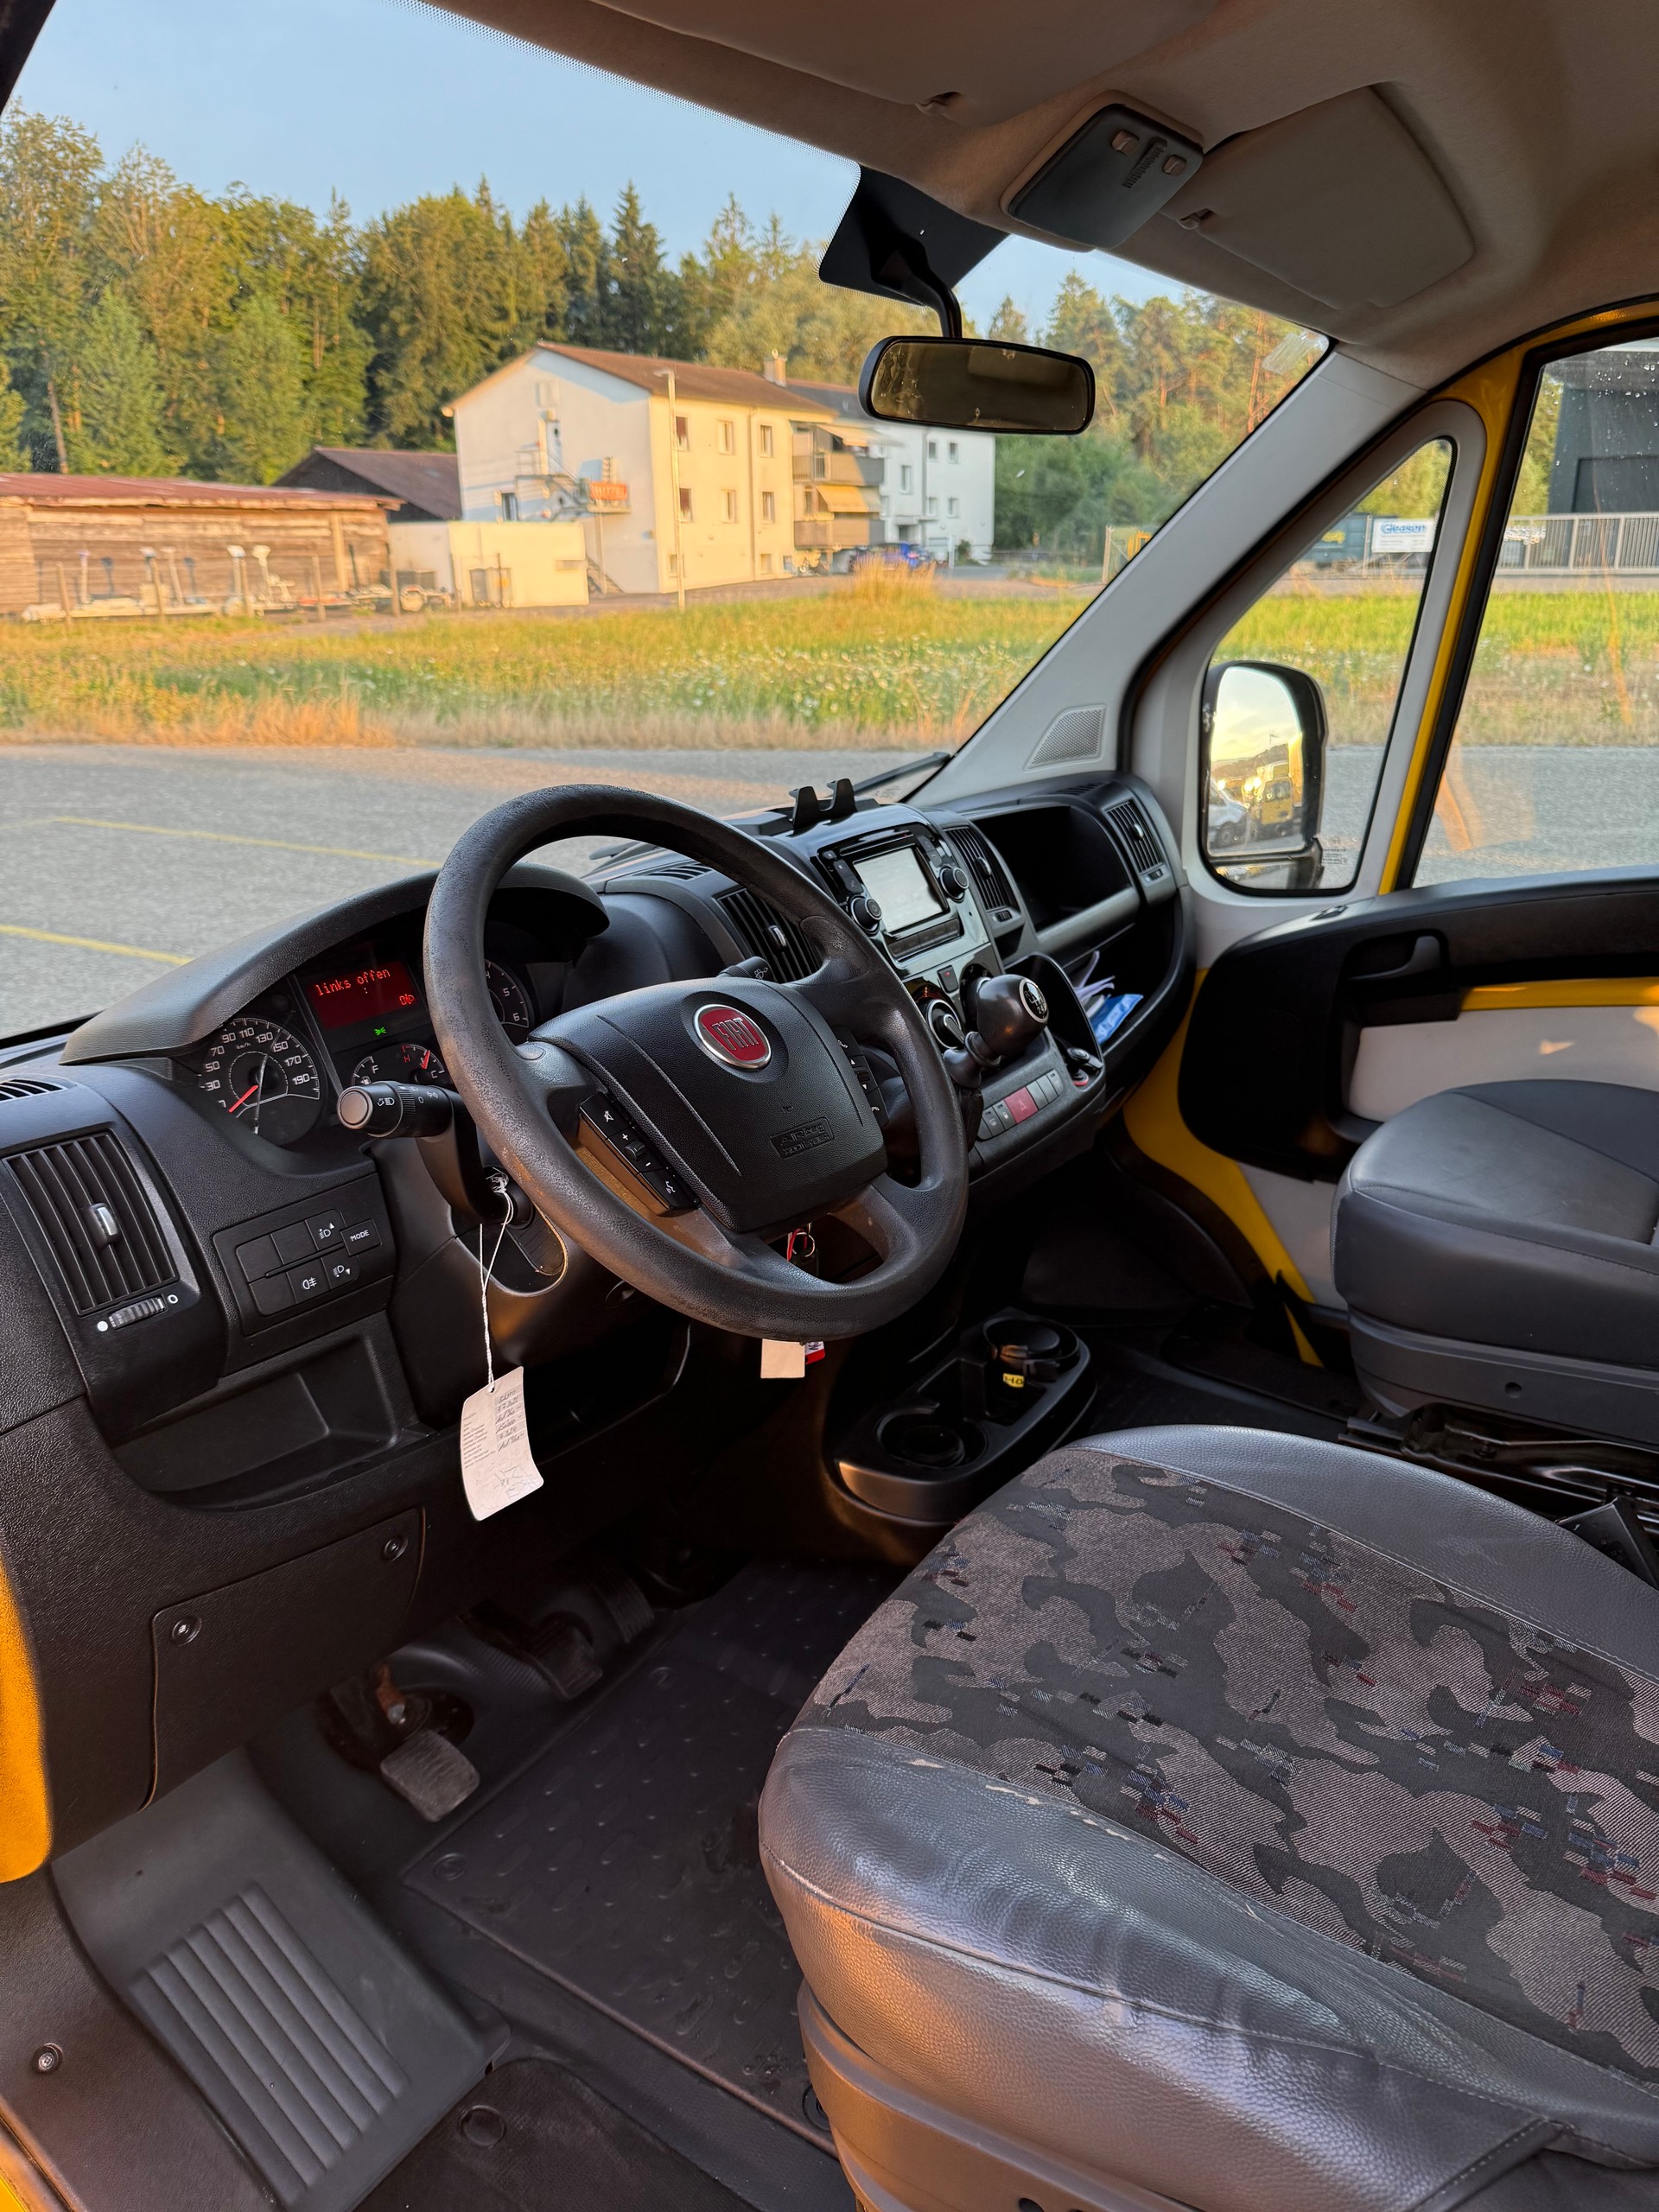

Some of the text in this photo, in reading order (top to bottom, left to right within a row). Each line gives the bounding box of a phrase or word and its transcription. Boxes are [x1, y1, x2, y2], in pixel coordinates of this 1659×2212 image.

[315, 969, 391, 996] links offen
[503, 987, 511, 997] 5
[512, 1012, 520, 1021] 6
[222, 1032, 237, 1044] 90
[238, 1027, 255, 1039] 110
[256, 1032, 274, 1044] 130
[711, 1017, 760, 1052] FIAT
[210, 1046, 225, 1057] 70
[272, 1040, 289, 1053] 150
[284, 1055, 302, 1067] 170
[404, 1054, 410, 1064] H
[205, 1060, 220, 1072] 50
[372, 1065, 379, 1074] F
[292, 1073, 310, 1085] 190
[430, 1071, 438, 1079] C
[206, 1079, 221, 1091] 30
[350, 1229, 370, 1242] MODE
